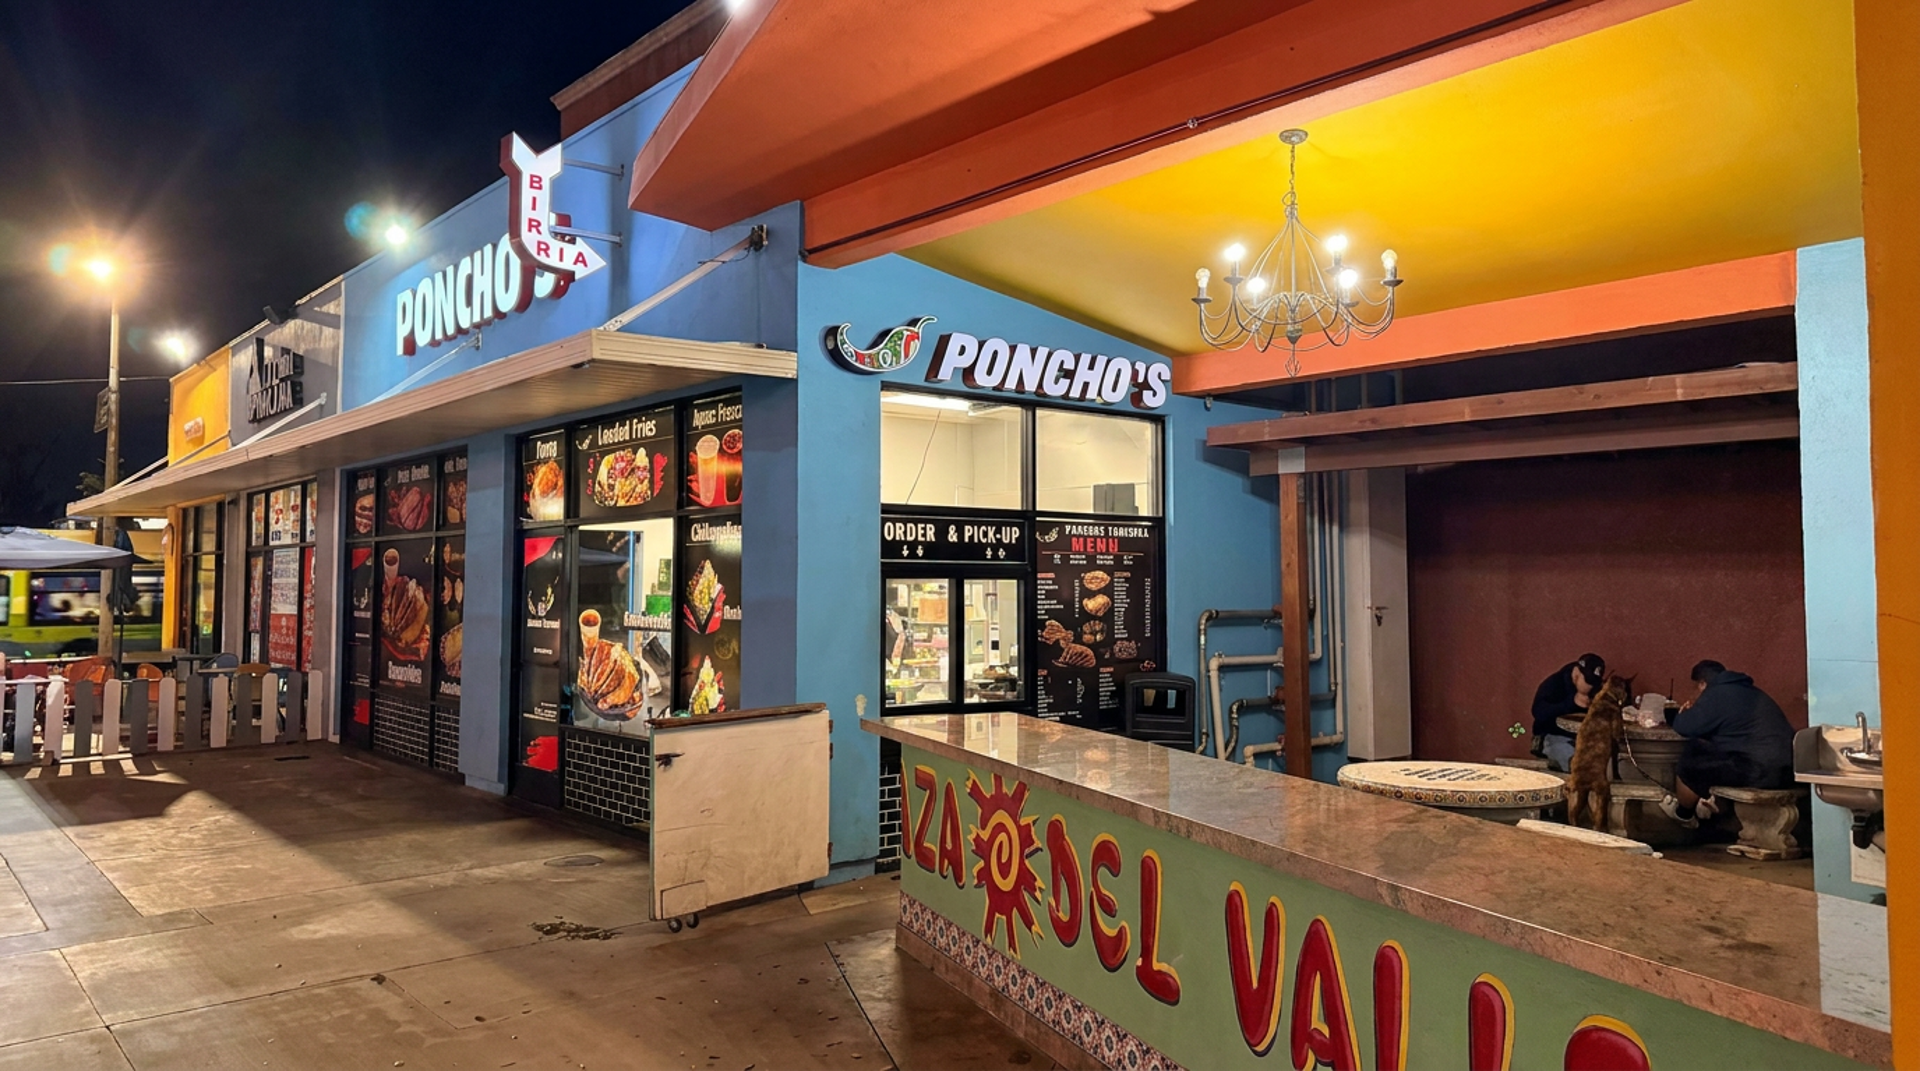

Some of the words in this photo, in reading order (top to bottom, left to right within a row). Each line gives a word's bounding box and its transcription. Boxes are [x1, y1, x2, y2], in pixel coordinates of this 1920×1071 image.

[525, 174, 588, 268] BIRRIA
[396, 213, 561, 356] PONCHO
[936, 331, 1172, 408] PONCHO'S
[884, 521, 936, 542] ORDER
[947, 524, 958, 543] &
[964, 525, 1020, 544] PICK-UP
[1071, 537, 1119, 553] MENU
[1046, 814, 1181, 1006] DEL
[1225, 881, 1650, 1071] VAL
